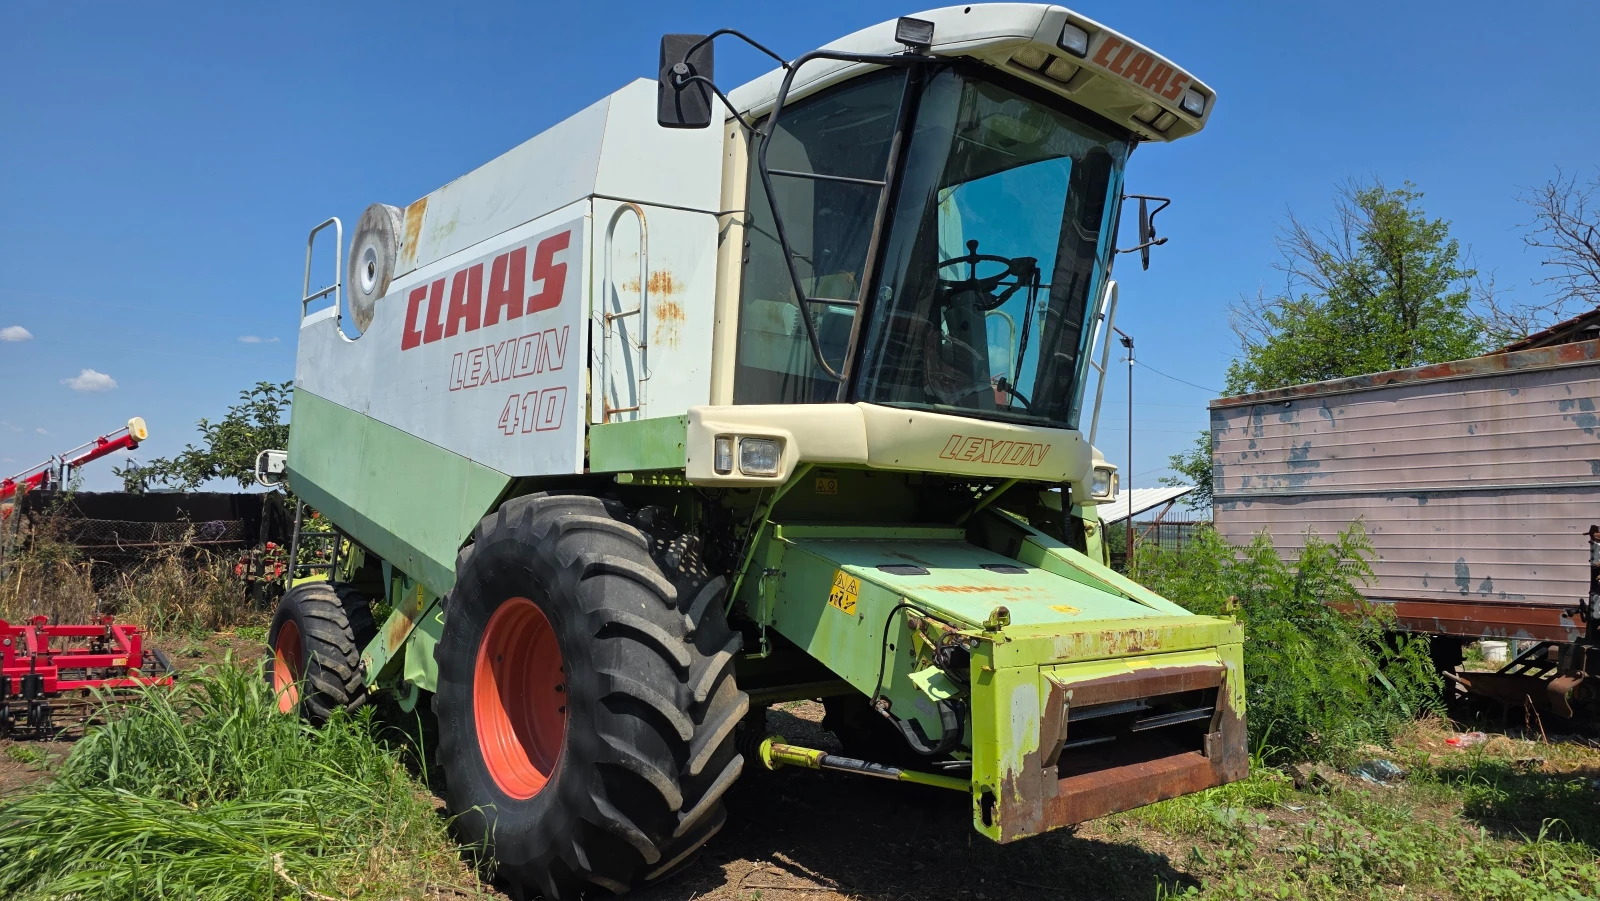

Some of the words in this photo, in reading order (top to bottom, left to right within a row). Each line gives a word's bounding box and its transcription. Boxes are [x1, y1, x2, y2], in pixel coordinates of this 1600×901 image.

[1092, 36, 1190, 101] CLAAS
[401, 229, 572, 351] CLAAS
[449, 325, 570, 392] LEXION
[498, 386, 567, 436] 410
[939, 434, 1051, 467] LEXION
